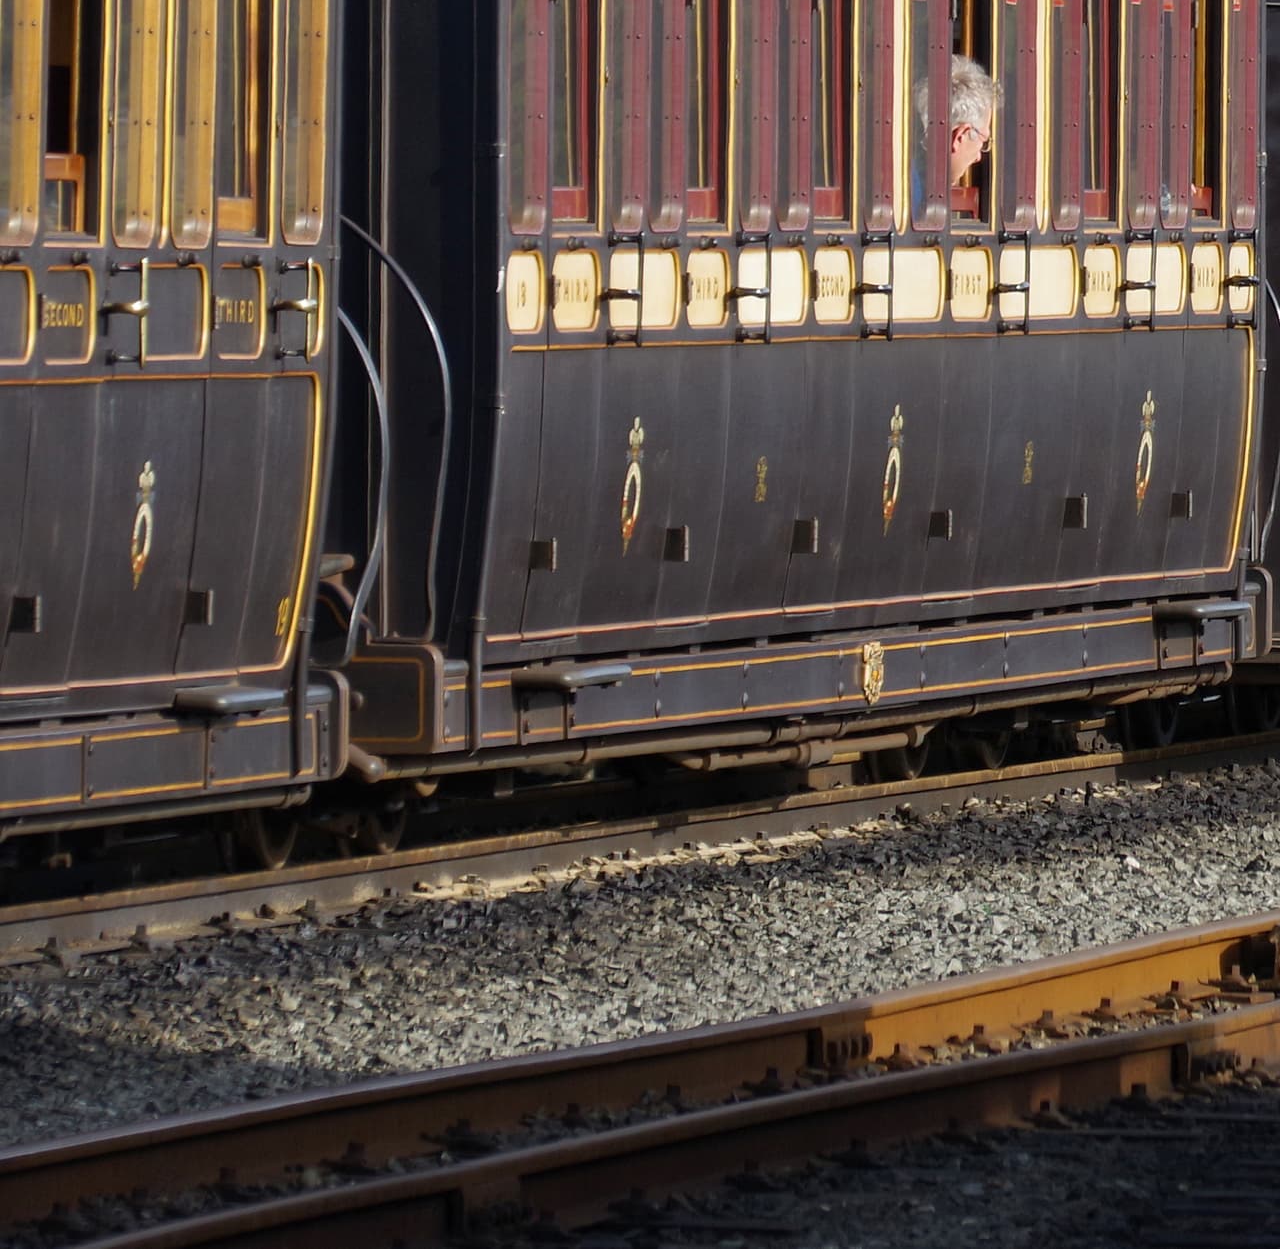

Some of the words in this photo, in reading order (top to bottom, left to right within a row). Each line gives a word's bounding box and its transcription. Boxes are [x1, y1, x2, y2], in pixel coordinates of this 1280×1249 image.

[556, 278, 589, 304] THIRD
[818, 274, 845, 298] ECOND
[954, 273, 982, 296] FIRST
[42, 302, 84, 327] SECOND
[217, 300, 255, 323] THIRD
